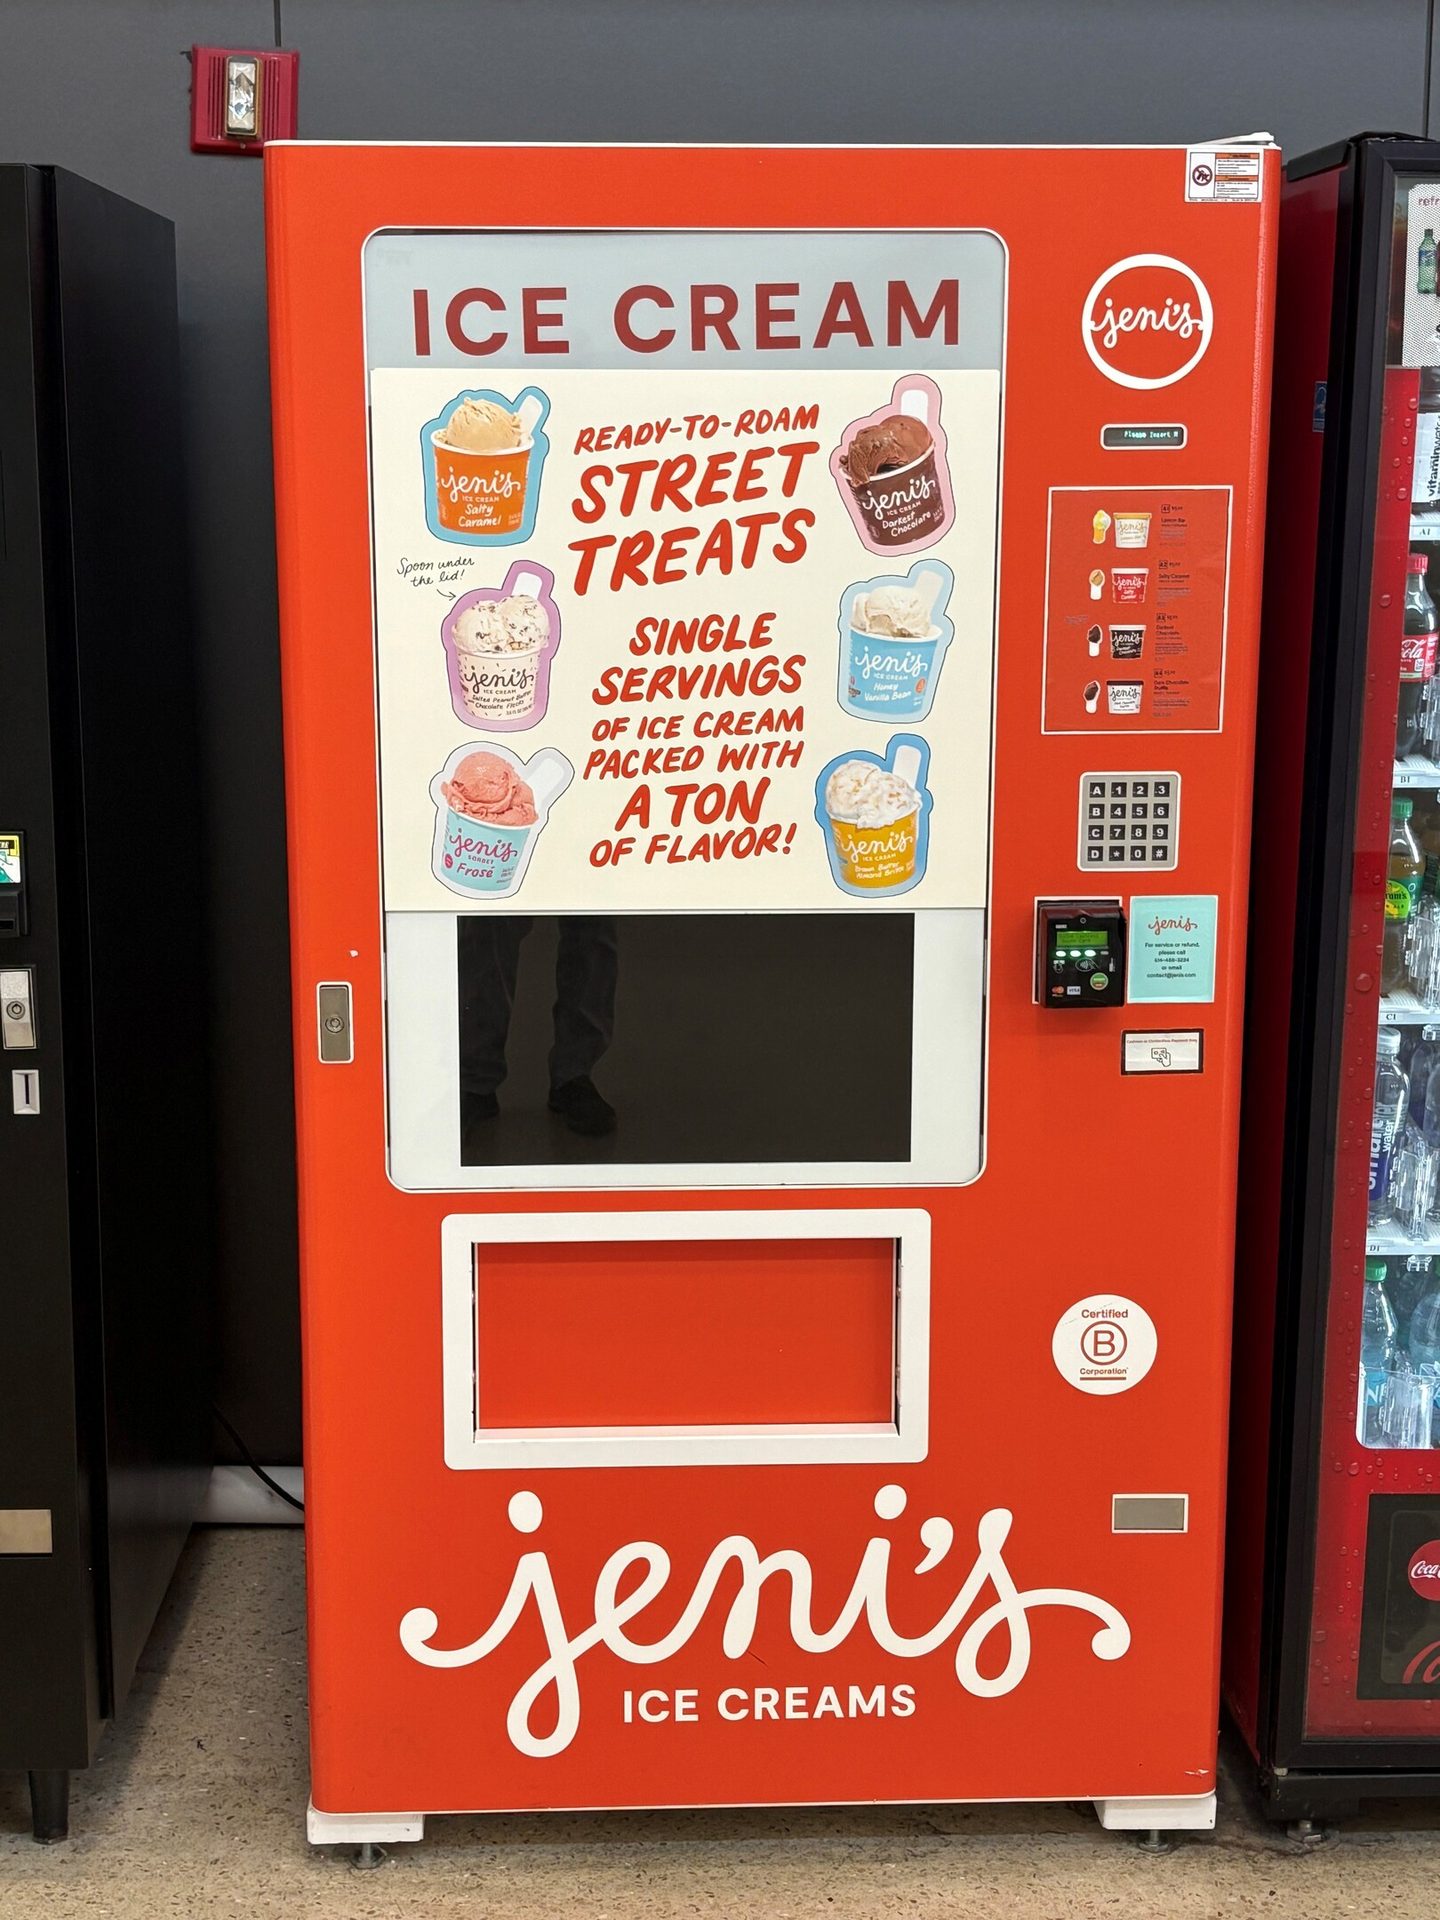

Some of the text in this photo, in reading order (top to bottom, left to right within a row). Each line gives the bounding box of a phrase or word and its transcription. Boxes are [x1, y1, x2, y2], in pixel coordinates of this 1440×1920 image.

[413, 278, 960, 356] ICE CREAM
[1090, 297, 1204, 348] jeni's
[574, 404, 820, 455] READY-TO-ROAM
[440, 466, 521, 503] jeni's
[571, 441, 820, 523] STREET
[465, 504, 494, 517] Salty
[862, 475, 936, 520] jeni's
[458, 515, 502, 528] Caramel
[882, 511, 915, 529] Darkest
[891, 511, 932, 537] Chocolate
[1420, 528, 1431, 536] A1
[568, 508, 816, 596] TREATS
[397, 556, 475, 578] Spoon under
[410, 569, 465, 587] the lid!
[629, 612, 777, 656] SINGLE
[855, 645, 928, 679] jeni's
[464, 665, 534, 694] jeni's
[592, 654, 806, 705] SERVINGS
[592, 705, 804, 741] OF ICE CREAM
[583, 740, 804, 780] PACKED WITH
[1092, 785, 1165, 795] A 1 2 3
[1400, 775, 1410, 783] B1
[614, 776, 771, 832] A TON
[1092, 807, 1164, 816] B 4 5 6
[449, 828, 518, 862] jeni's
[589, 822, 797, 868] OF FLAVOR!
[841, 830, 913, 863] jeni's
[1091, 828, 1164, 837] C 7 8 9
[468, 855, 494, 865] SORBET
[1091, 849, 1163, 859] D 0 #
[456, 863, 495, 878] Frosé
[1386, 1013, 1396, 1021] C1
[1369, 1244, 1380, 1252] D1
[1081, 1308, 1129, 1319] Certified
[1093, 1330, 1116, 1356] B
[400, 1484, 1131, 1758] jeni's
[623, 1683, 917, 1723] ICE CREAMS
